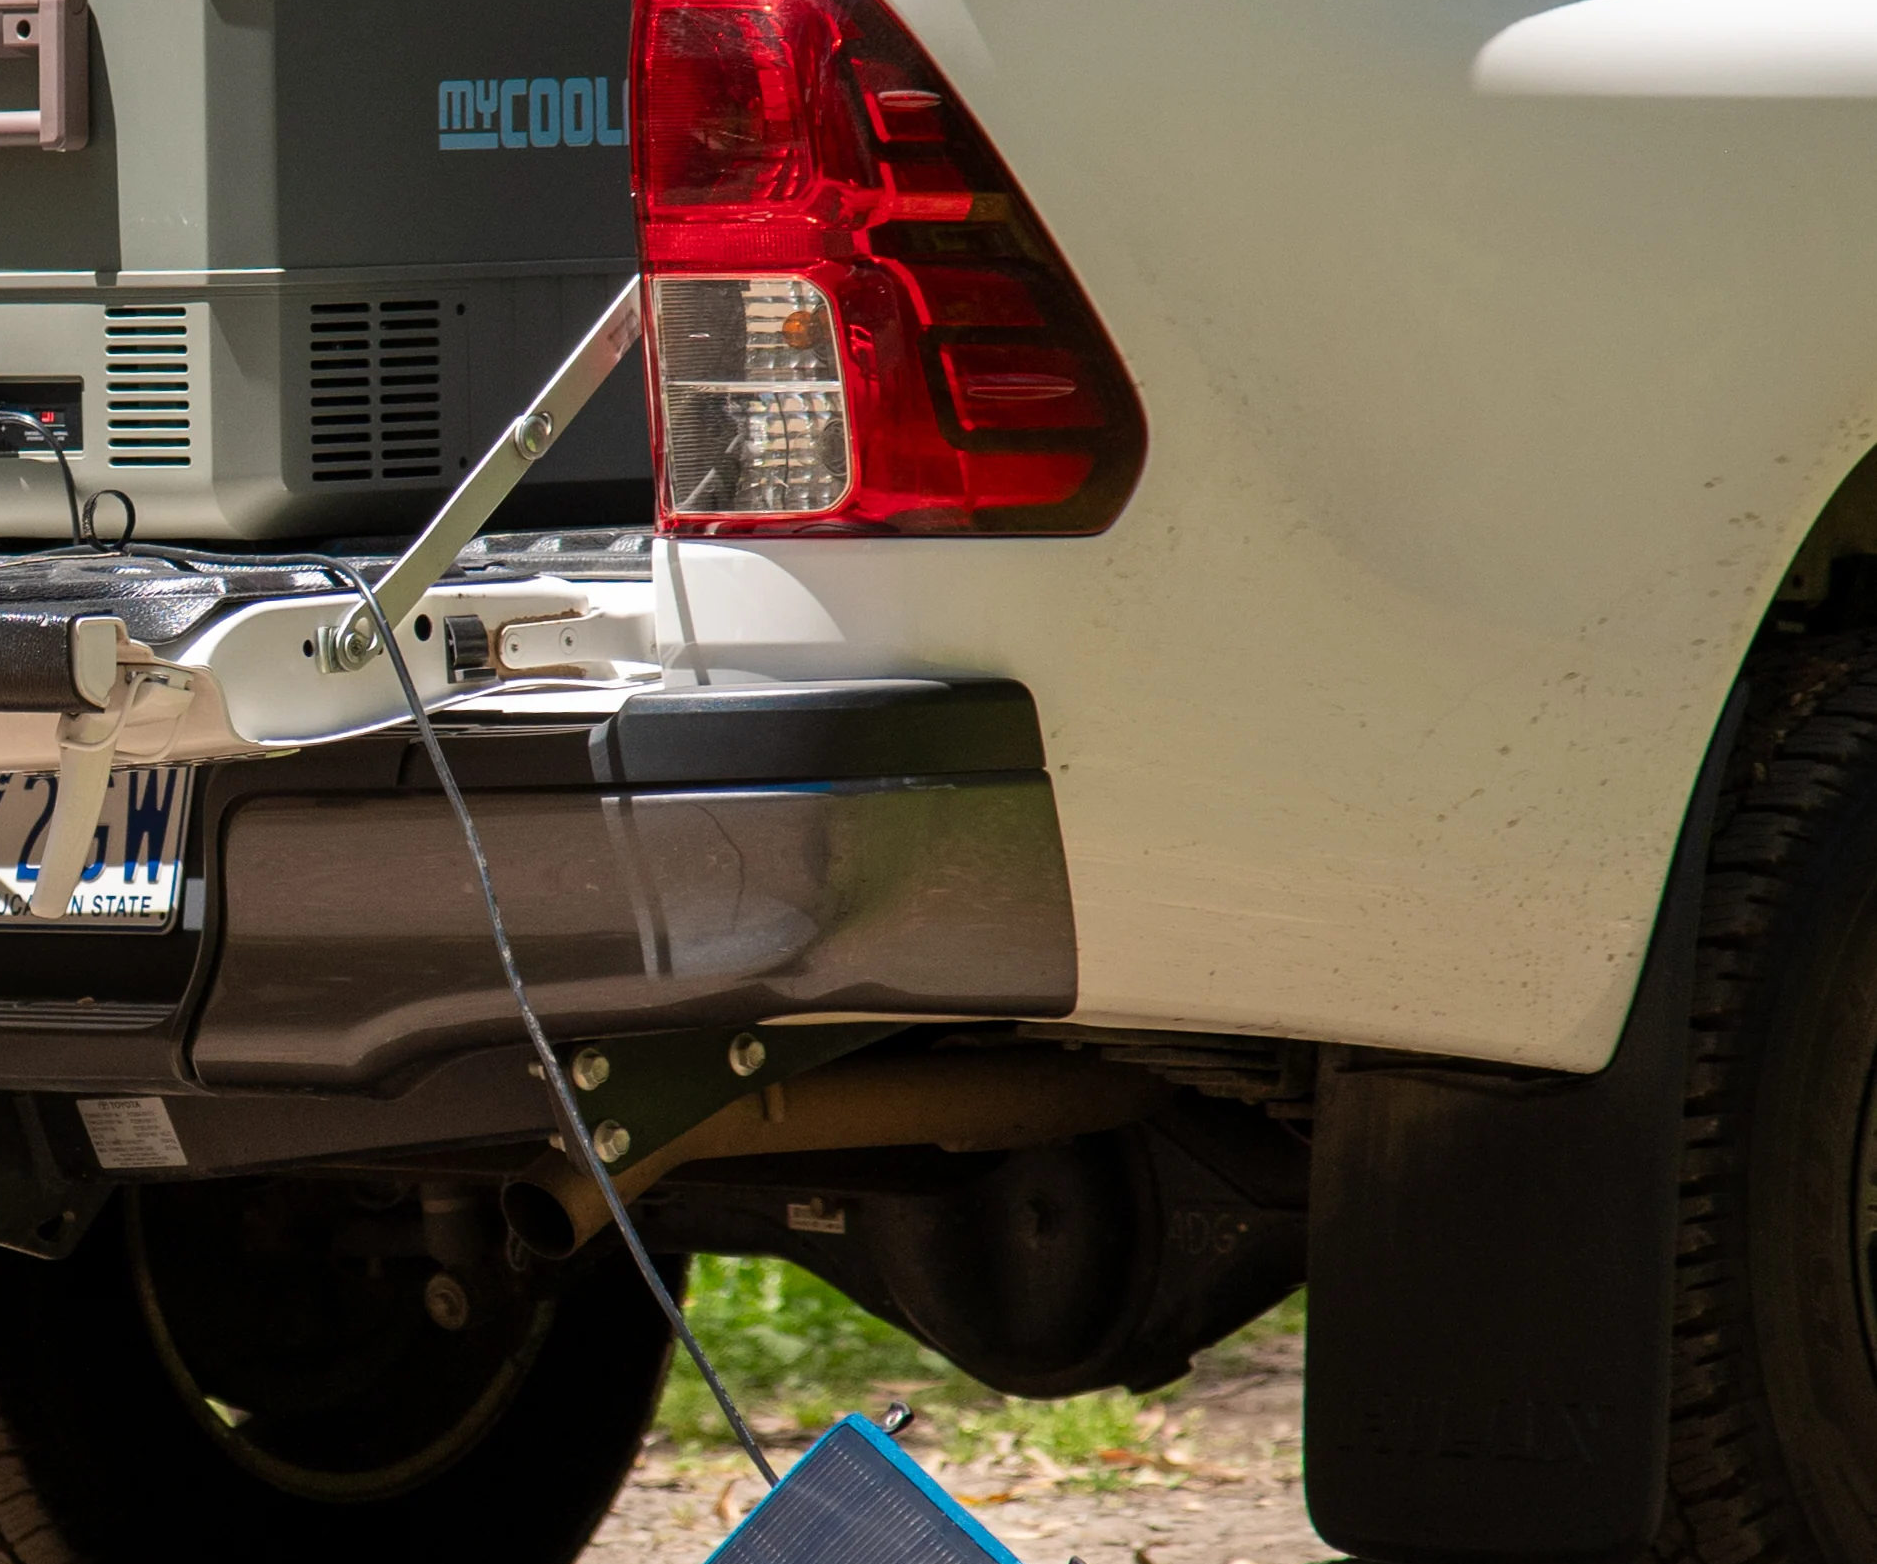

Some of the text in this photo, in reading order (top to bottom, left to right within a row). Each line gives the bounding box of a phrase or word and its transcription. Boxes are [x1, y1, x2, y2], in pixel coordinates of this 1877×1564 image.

[438, 77, 629, 150] MYCOOL
[91, 895, 153, 918] STATE
[110, 1100, 141, 1109] TOYOTA
